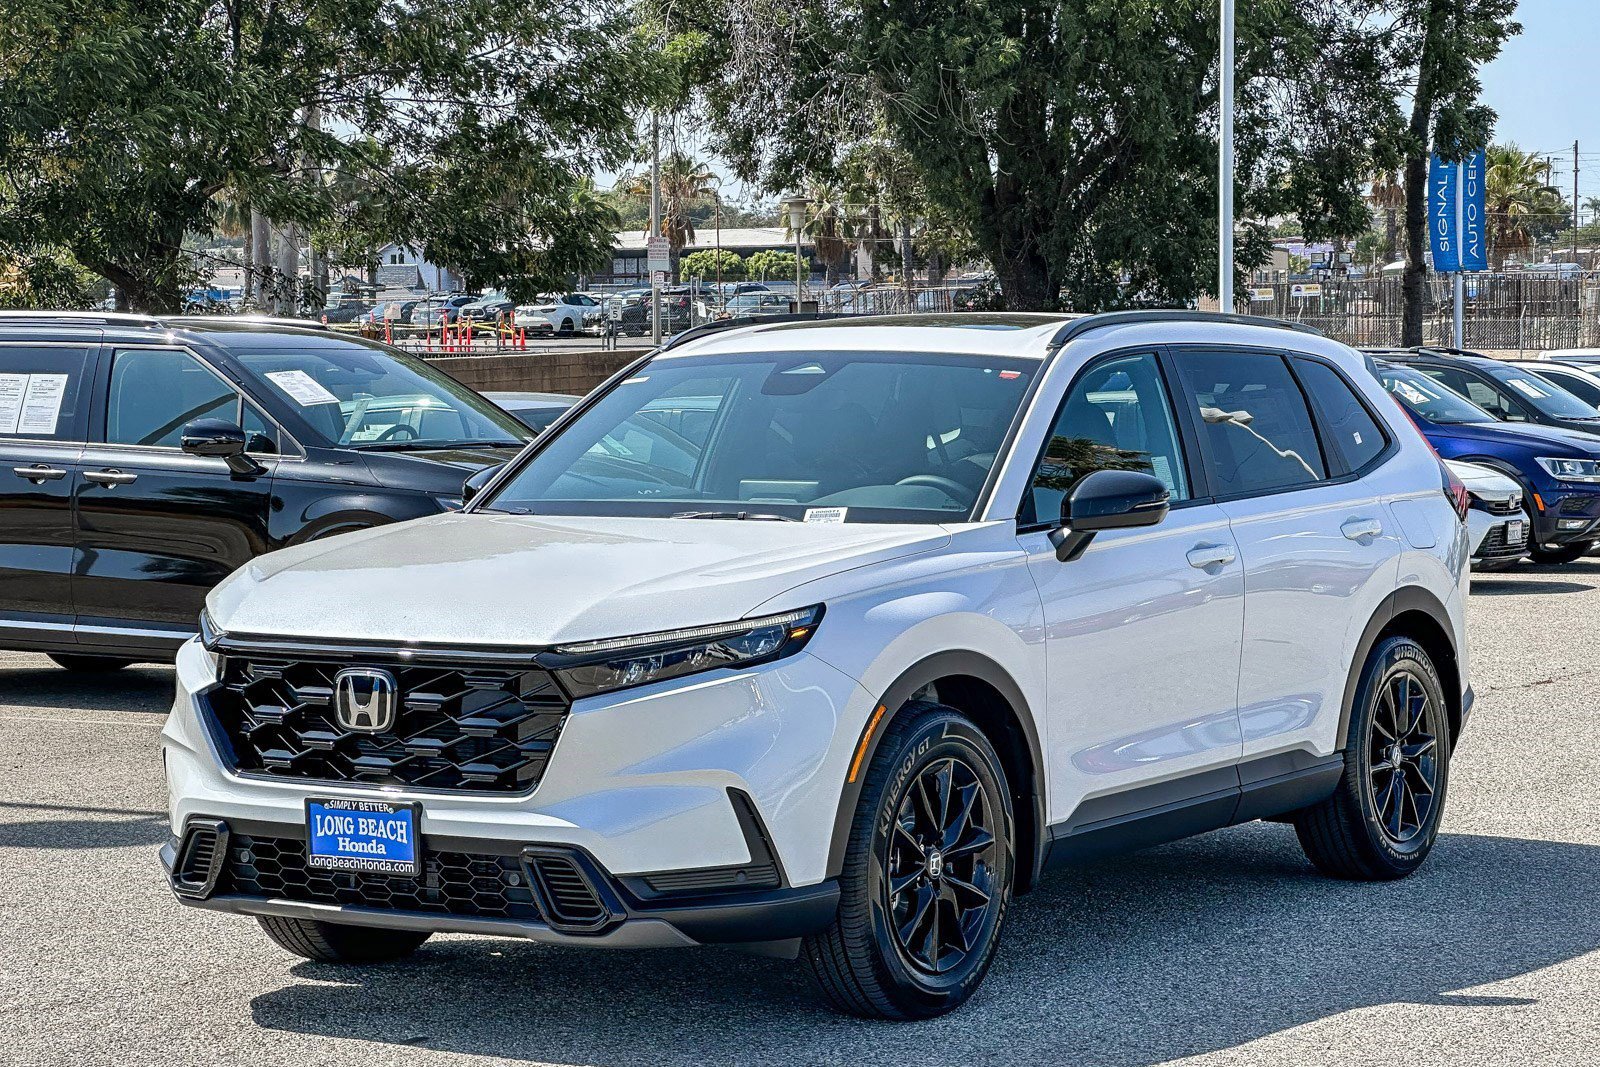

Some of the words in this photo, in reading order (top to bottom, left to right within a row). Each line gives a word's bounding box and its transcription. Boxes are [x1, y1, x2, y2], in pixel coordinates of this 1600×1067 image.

[1467, 154, 1477, 197] CEN
[1437, 174, 1450, 252] SIGNAL
[1467, 203, 1479, 259] AUTO
[612, 310, 619, 319] 5
[878, 746, 916, 838] KINERGY
[917, 736, 931, 756] GT
[329, 799, 356, 811] SIMPLY
[358, 802, 389, 813] BETTER
[315, 814, 355, 837] LONG
[357, 817, 408, 844] BEACH
[337, 836, 387, 855] Honda
[309, 854, 414, 873] LongBeachHonda.com
